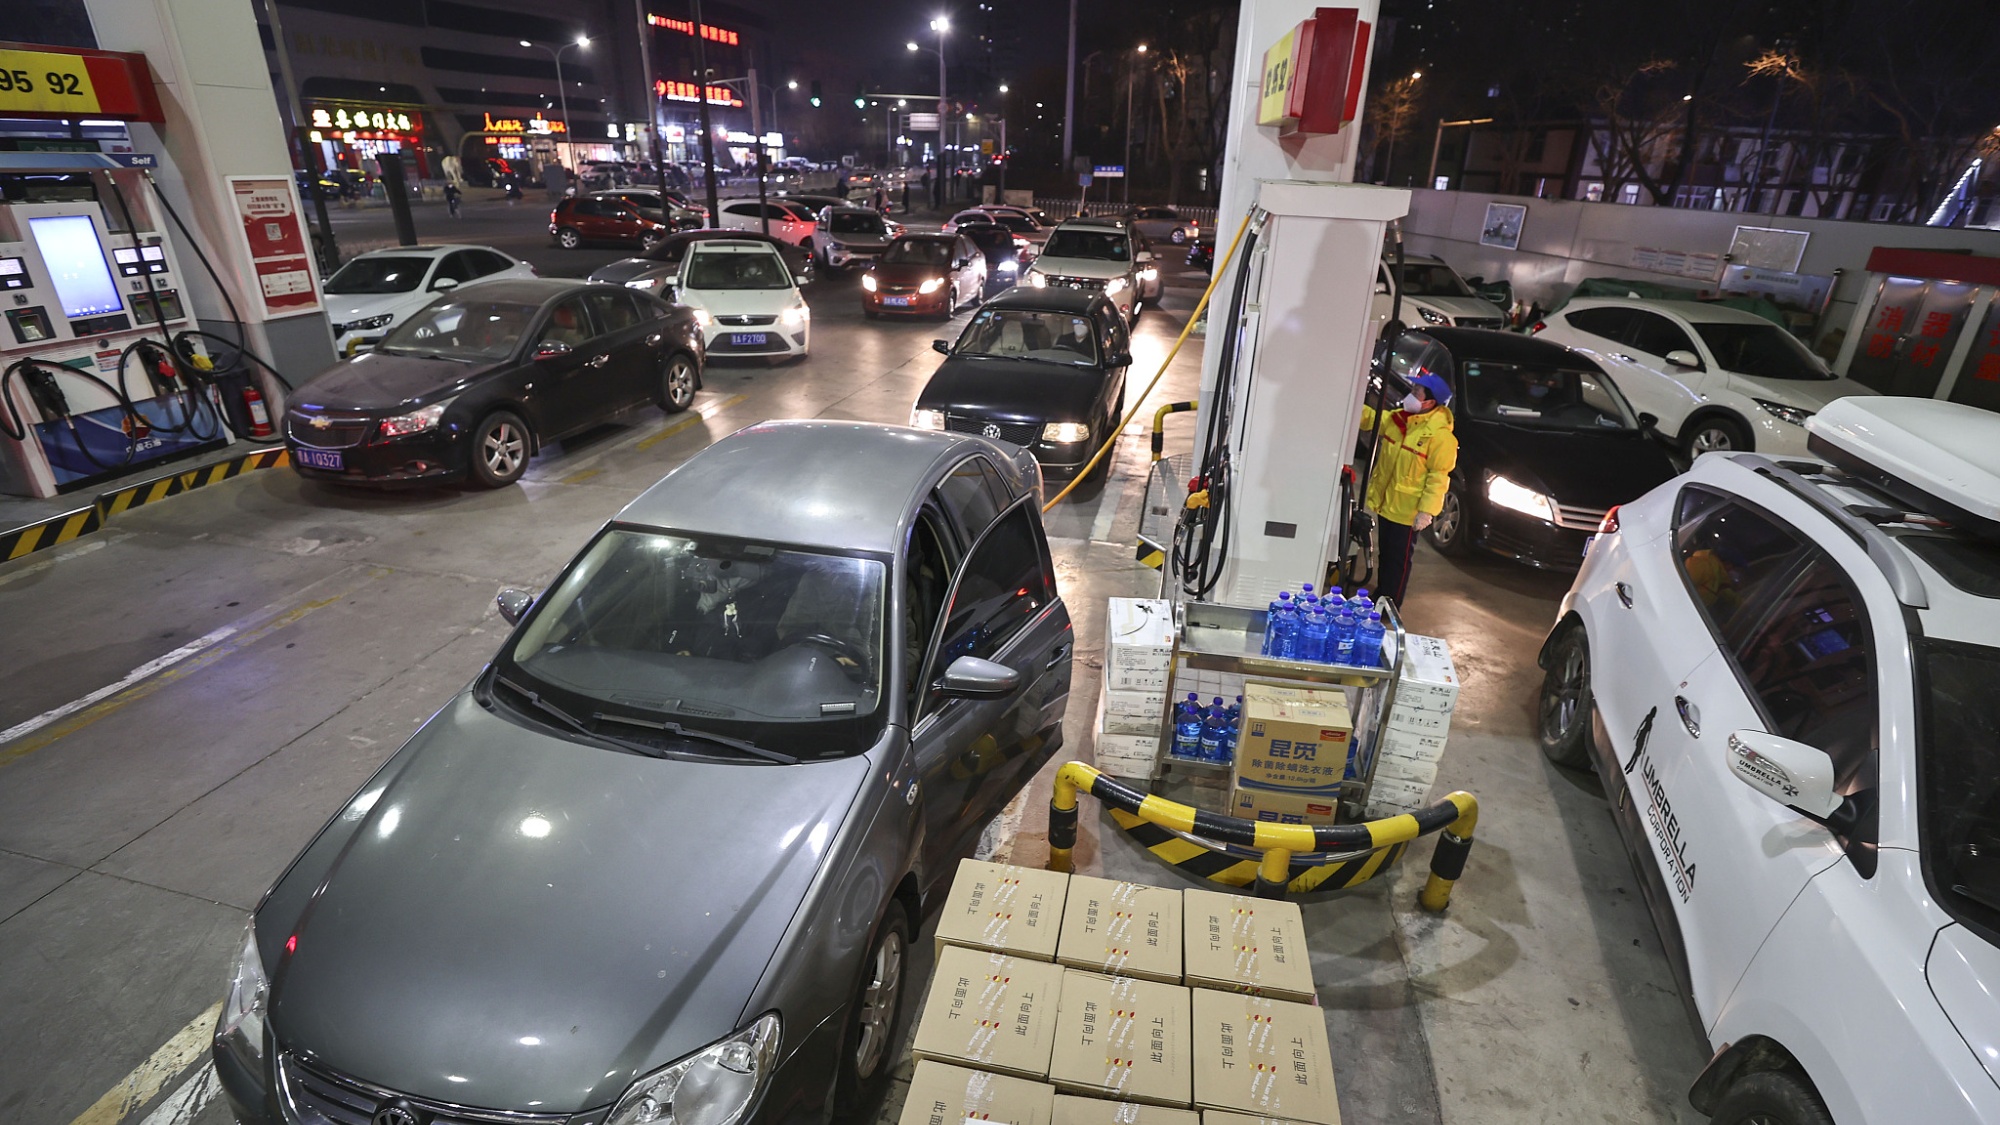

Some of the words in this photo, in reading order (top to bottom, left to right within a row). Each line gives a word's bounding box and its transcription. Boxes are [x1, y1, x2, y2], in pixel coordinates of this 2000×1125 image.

[0, 68, 33, 93] 95
[45, 72, 84, 96] 92
[131, 157, 151, 165] Self
[14, 295, 28, 304] 10
[132, 281, 143, 290] 11
[157, 278, 167, 288] 12
[1910, 311, 1953, 368] 器材
[1251, 758, 1334, 776] 除菌除螨洗衣液
[1269, 738, 1318, 761] 昆觅
[1735, 765, 1774, 788] CORPORATION
[1739, 759, 1782, 786] UMBRELLA
[1643, 756, 1696, 889] UMBRELLA
[1646, 804, 1690, 904] CORPORATION
[967, 882, 986, 915] 此面向上
[1027, 893, 1043, 928] 此面向上
[1085, 899, 1100, 933] 此面向上
[1146, 911, 1159, 947] 此面向上
[1209, 915, 1221, 951] 此面向上
[1270, 927, 1286, 964] 此面向上
[948, 976, 970, 1020] 此面向上
[1014, 992, 1034, 1036] 此面向上
[1081, 1001, 1098, 1046] 此面向上
[1150, 1017, 1164, 1064] 此面向上
[1221, 1022, 1236, 1069] 此面向上
[1290, 1037, 1308, 1086] 此面向上
